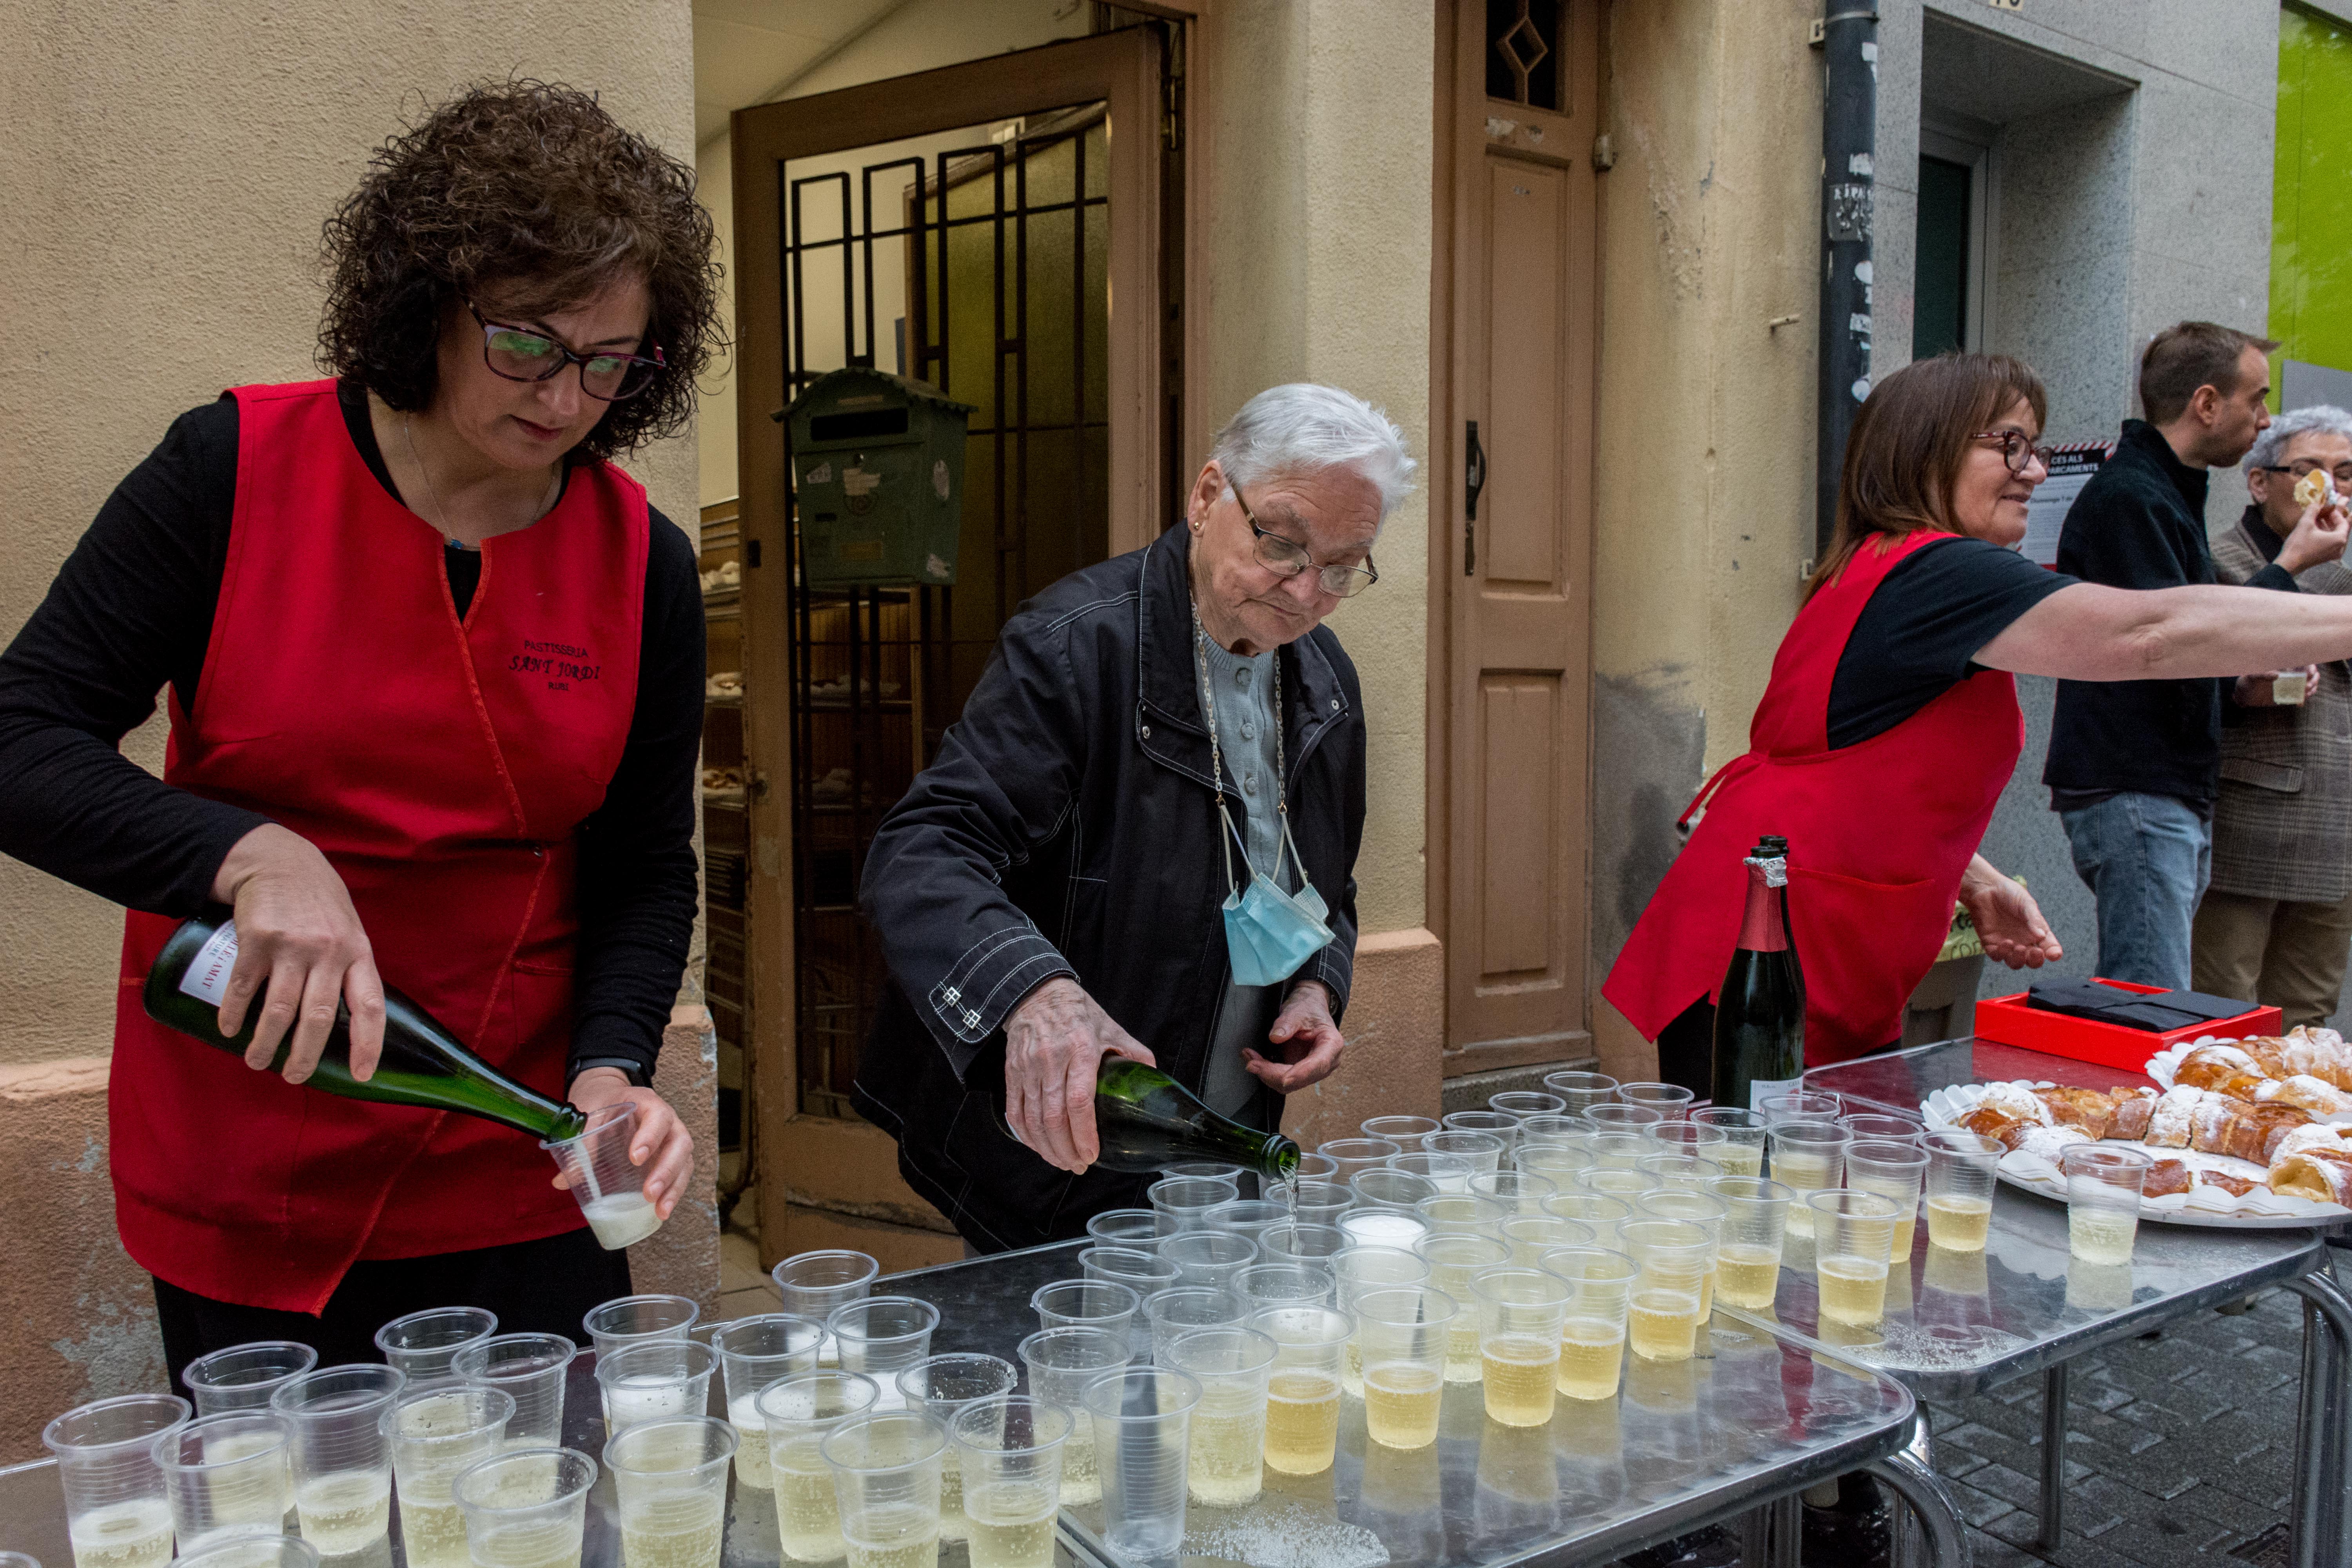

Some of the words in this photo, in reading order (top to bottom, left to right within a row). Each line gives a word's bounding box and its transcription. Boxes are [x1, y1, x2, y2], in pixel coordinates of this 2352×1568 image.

[2067, 453, 2083, 463] ALS
[524, 640, 588, 657] PASTISSERIA
[509, 655, 554, 674] SANT
[557, 661, 601, 682] JORDI
[209, 932, 233, 956] NATURE
[202, 962, 223, 989] AMAT
